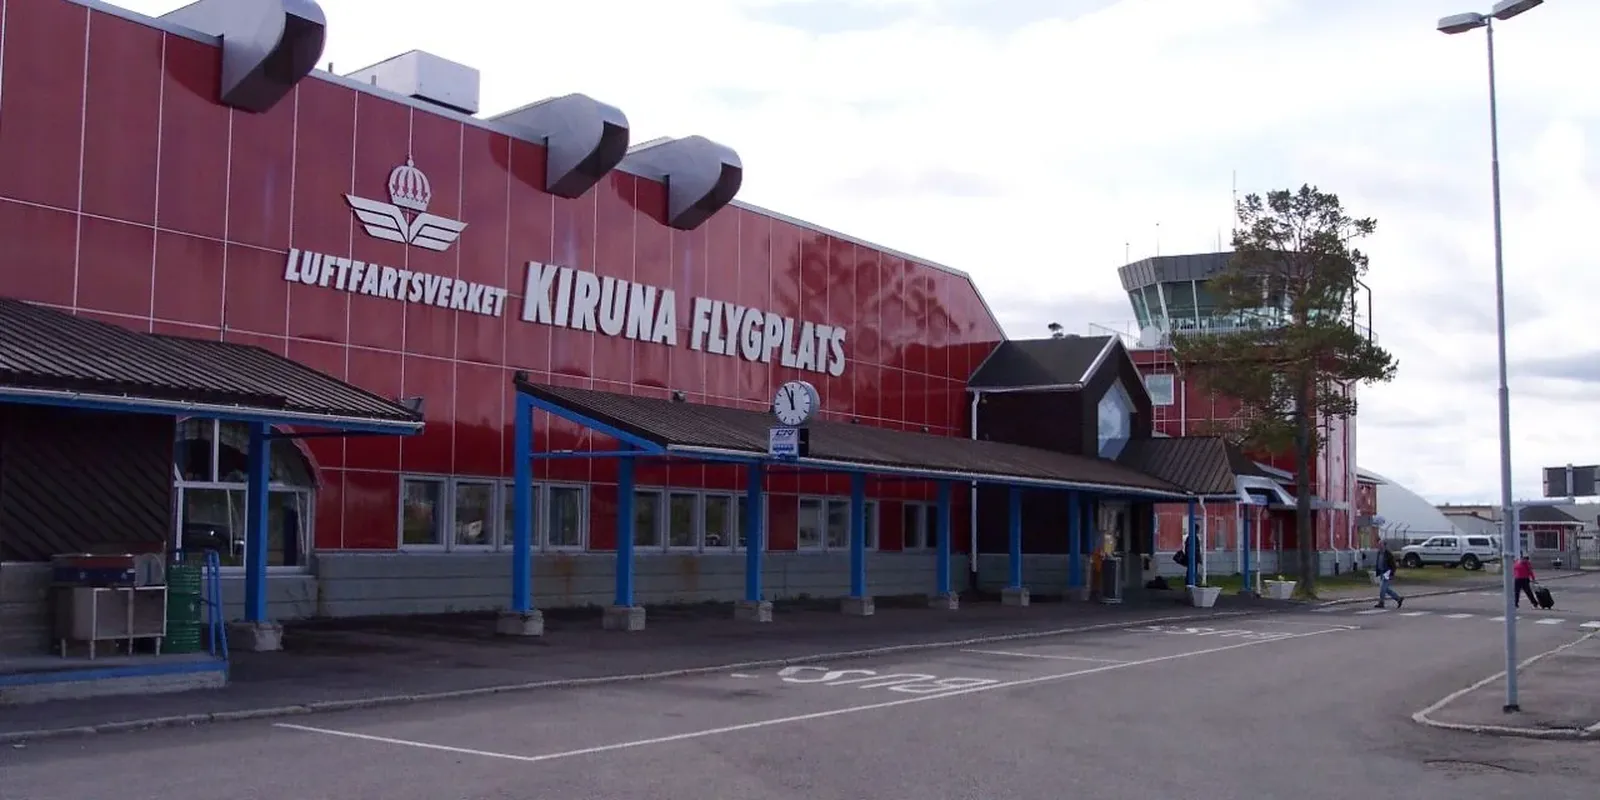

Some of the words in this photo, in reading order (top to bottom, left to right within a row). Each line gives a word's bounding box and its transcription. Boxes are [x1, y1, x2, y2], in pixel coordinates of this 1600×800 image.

[285, 248, 508, 317] LUFTFARTSVERKET
[522, 261, 677, 346] KIRUNA
[691, 297, 847, 377] FLYGPLATS
